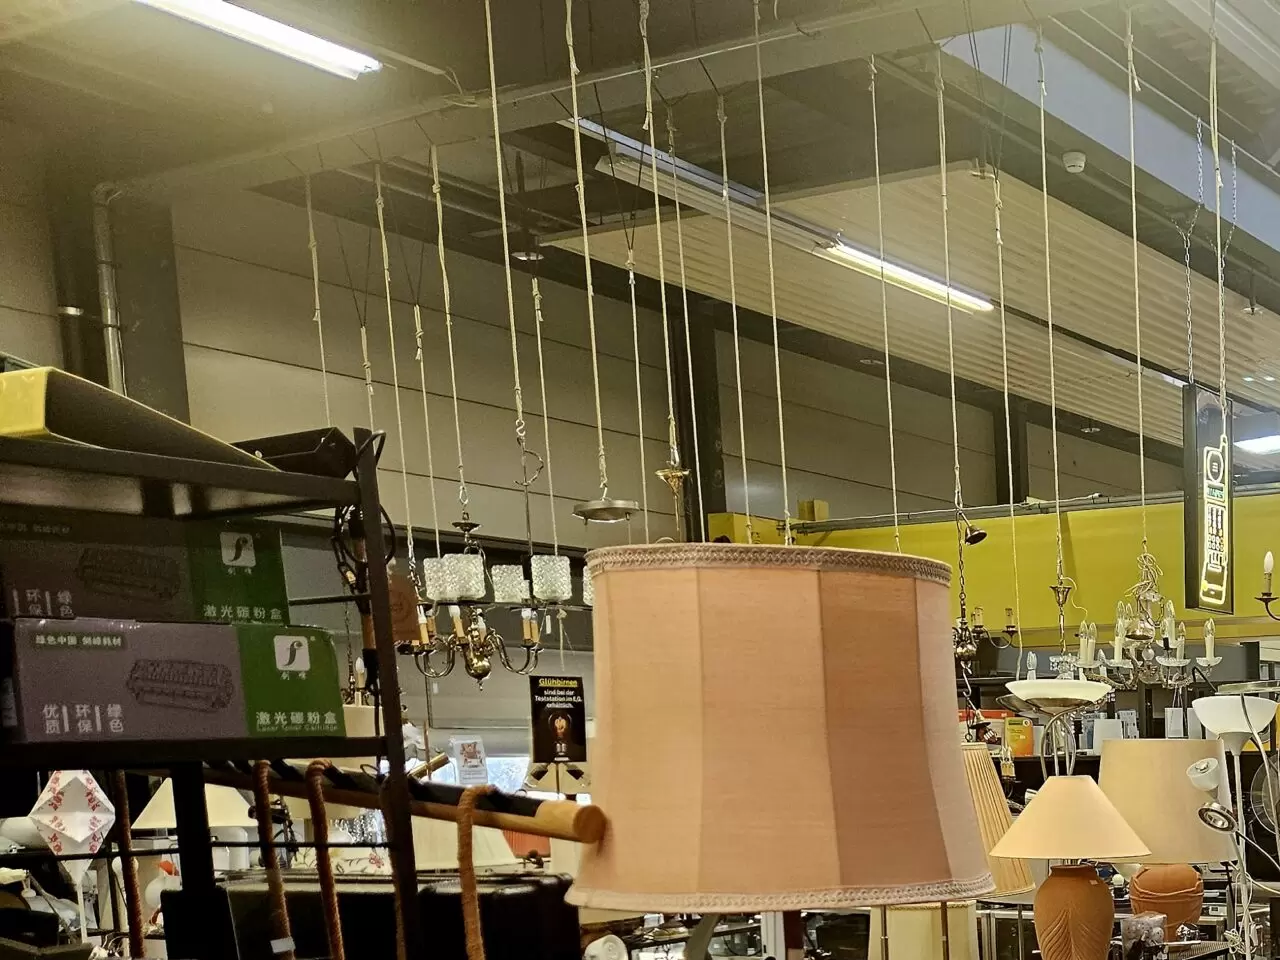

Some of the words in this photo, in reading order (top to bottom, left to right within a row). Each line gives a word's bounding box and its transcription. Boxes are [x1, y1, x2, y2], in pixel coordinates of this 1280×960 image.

[539, 678, 577, 687] Glühbirnen
[42, 703, 61, 734] 优质
[75, 703, 93, 733] 环保
[107, 703, 124, 733] 绿色
[256, 711, 338, 725] 激光碳粉盒
